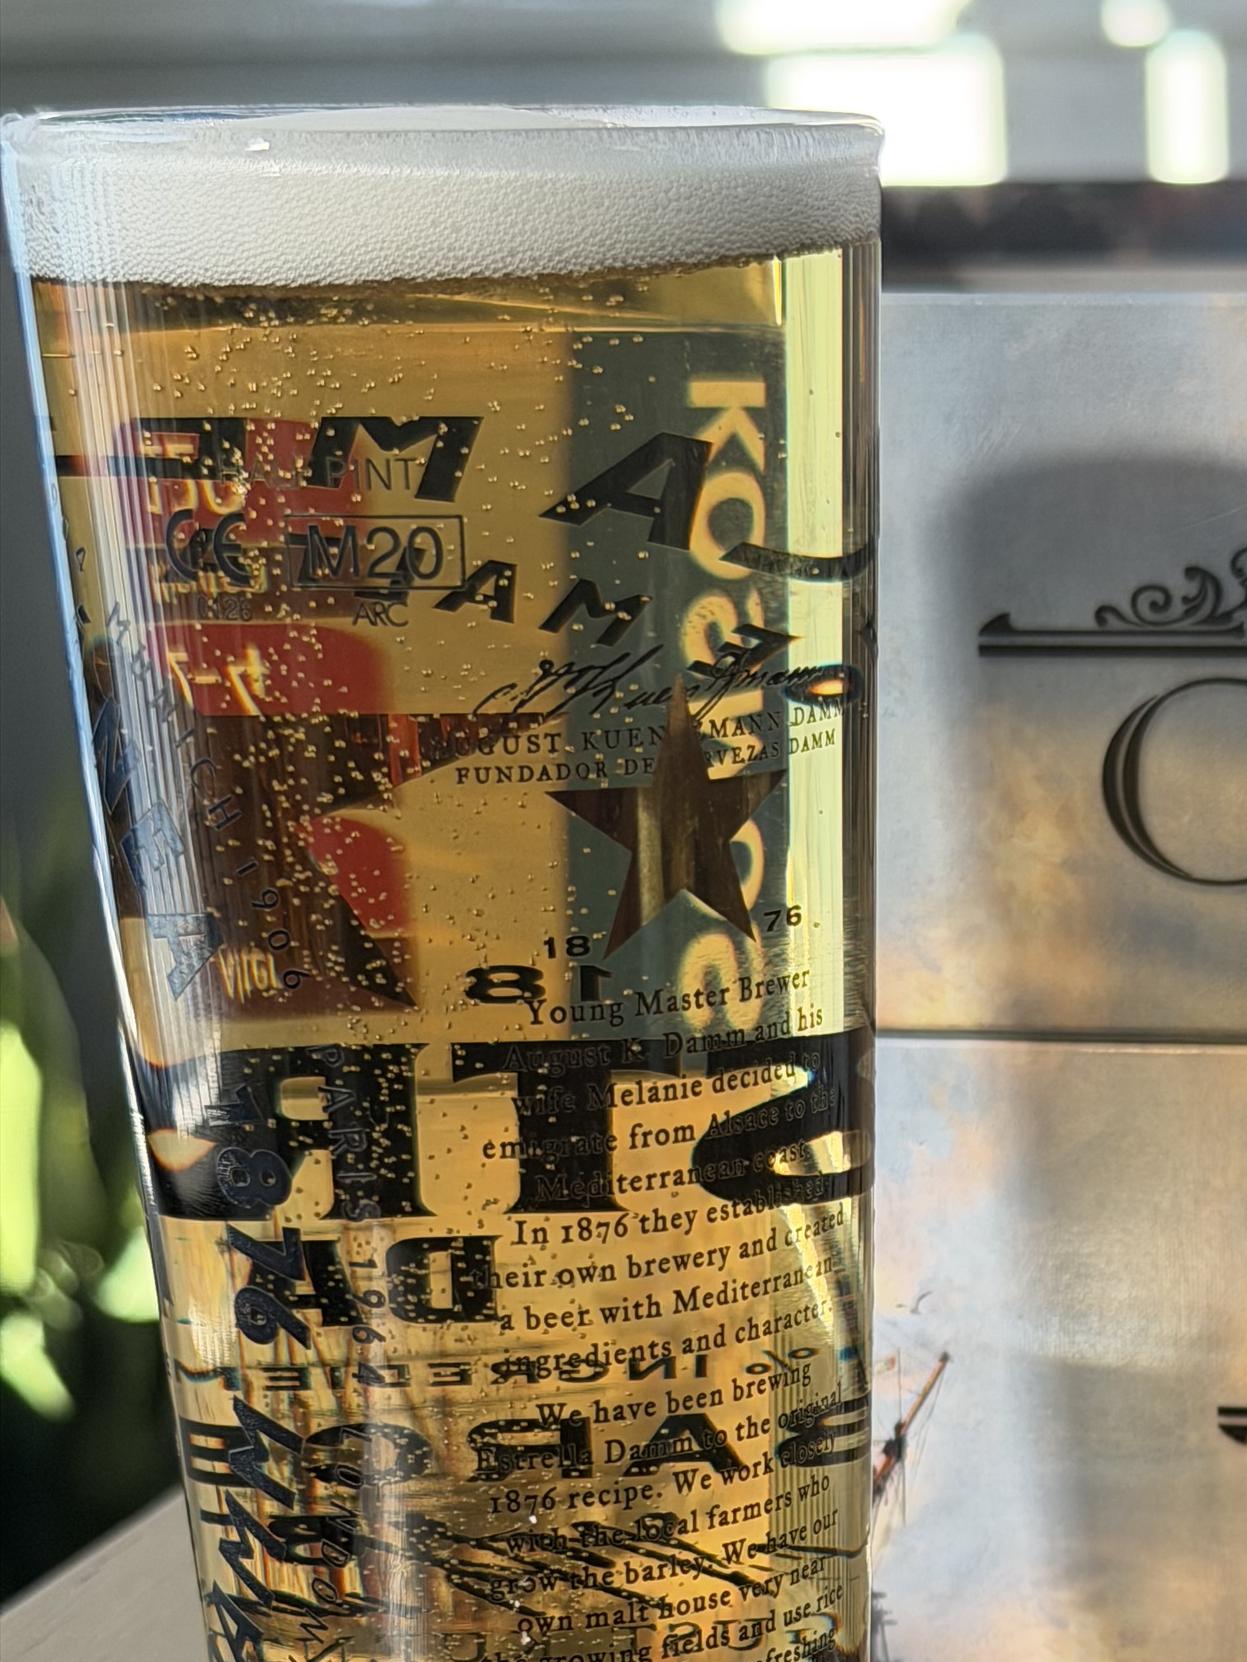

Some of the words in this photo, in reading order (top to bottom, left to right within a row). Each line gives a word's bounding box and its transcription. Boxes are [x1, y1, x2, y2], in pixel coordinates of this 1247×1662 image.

[326, 457, 418, 492] PINT
[306, 524, 445, 581] M20
[352, 602, 409, 628] ARC
[456, 761, 608, 785] FUNDADOR
[624, 757, 657, 777] DE
[789, 728, 837, 755] DAMM
[235, 859, 311, 990] 1906
[542, 933, 592, 959] 18
[763, 904, 803, 934] 76
[524, 998, 625, 1029] Young
[635, 984, 731, 1016] Master
[738, 967, 811, 1004] Brewer
[502, 1042, 610, 1079] August
[662, 1028, 747, 1058] Damm
[754, 1011, 791, 1041] and
[797, 1002, 824, 1032] his
[511, 1085, 577, 1116] wife
[587, 1073, 703, 1111] Melanie
[711, 1051, 796, 1095] decided
[482, 1132, 618, 1165] emigrate
[629, 1122, 697, 1150] from
[706, 1106, 780, 1139] Alsace
[305, 1044, 381, 1223] PARIS
[349, 1258, 387, 1387] 1964
[534, 1157, 746, 1202] Mediterranean
[203, 1085, 311, 1350] 1876
[470, 1263, 547, 1290] their
[557, 1263, 617, 1288] own
[626, 1243, 731, 1280] brewery
[738, 1226, 778, 1259] and
[784, 1201, 844, 1248] created
[513, 1218, 550, 1247] In
[561, 1210, 630, 1244] 1876
[638, 1205, 698, 1236] they
[499, 1313, 515, 1332] a
[525, 1305, 594, 1331] beer
[600, 1299, 663, 1325] with
[673, 1256, 833, 1315] Mediterranean
[502, 1337, 672, 1379] ingredients
[681, 1325, 726, 1355] and
[474, 1443, 593, 1474] Estrella
[604, 1434, 695, 1465] Damm
[700, 1427, 728, 1451] to
[735, 1415, 771, 1442] the
[777, 1380, 842, 1430] original
[536, 1403, 583, 1429] We
[594, 1398, 658, 1426] have
[665, 1389, 724, 1415] been
[732, 1361, 812, 1402] brewing
[489, 1487, 557, 1516] 1876
[567, 1481, 664, 1511] recipe.
[672, 1469, 713, 1497] We
[718, 1451, 774, 1487] work
[779, 1433, 835, 1469] closely
[505, 1526, 569, 1556] with
[579, 1518, 625, 1547] the
[631, 1509, 699, 1544] local
[706, 1490, 793, 1530] farmers
[797, 1474, 831, 1502] who
[489, 1569, 563, 1602] grow
[569, 1564, 615, 1592] the
[625, 1553, 715, 1584] barley.
[722, 1538, 757, 1566] We
[765, 1525, 808, 1554] have
[812, 1508, 839, 1536] our
[517, 1611, 574, 1638] own
[585, 1602, 650, 1629] malt
[657, 1587, 732, 1619] house
[738, 1572, 785, 1602] very
[789, 1555, 827, 1587] near
[661, 1626, 732, 1661] fields
[738, 1609, 777, 1642] and
[783, 1601, 812, 1628] use
[816, 1584, 844, 1613] rice
